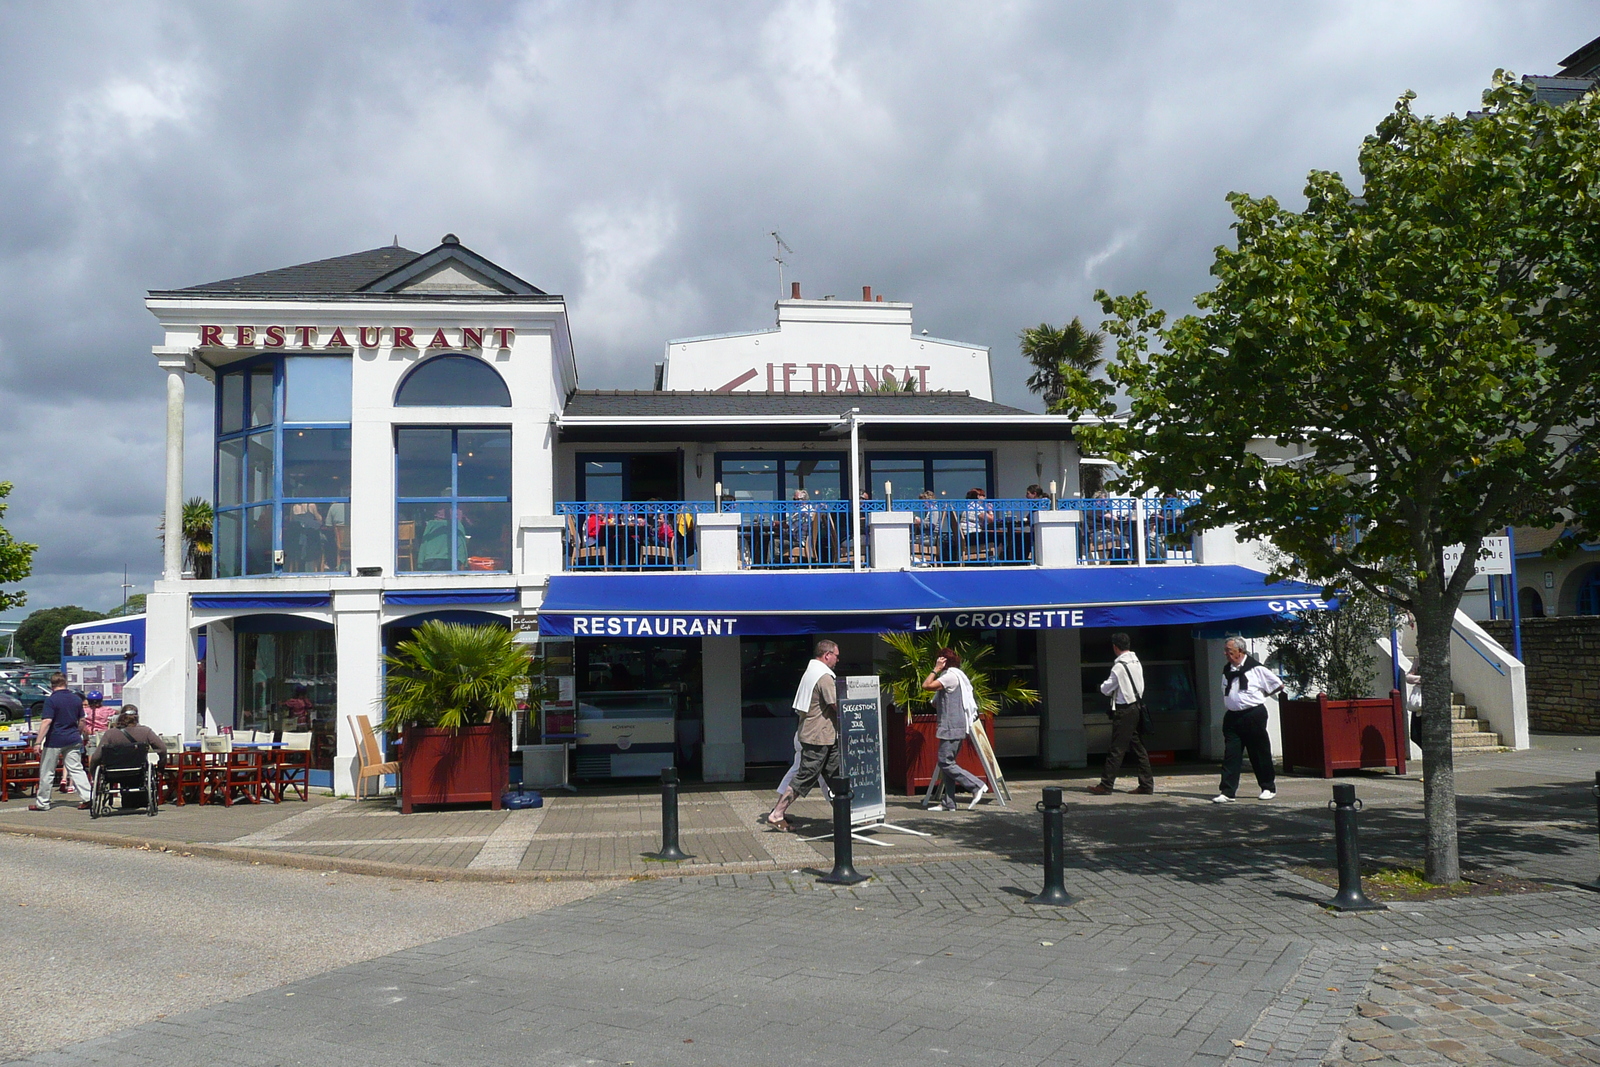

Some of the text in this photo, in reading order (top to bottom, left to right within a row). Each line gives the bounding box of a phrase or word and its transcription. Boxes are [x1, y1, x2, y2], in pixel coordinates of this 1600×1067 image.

[199, 325, 516, 348] RESTAURANT
[806, 363, 931, 392] TRANSAT
[1267, 598, 1329, 612] CAFE
[573, 617, 737, 635] RESTAURANT
[915, 610, 1084, 631] LA CROISETTE
[842, 703, 876, 712] SUGGESTIONS
[851, 720, 864, 728] JOUR
